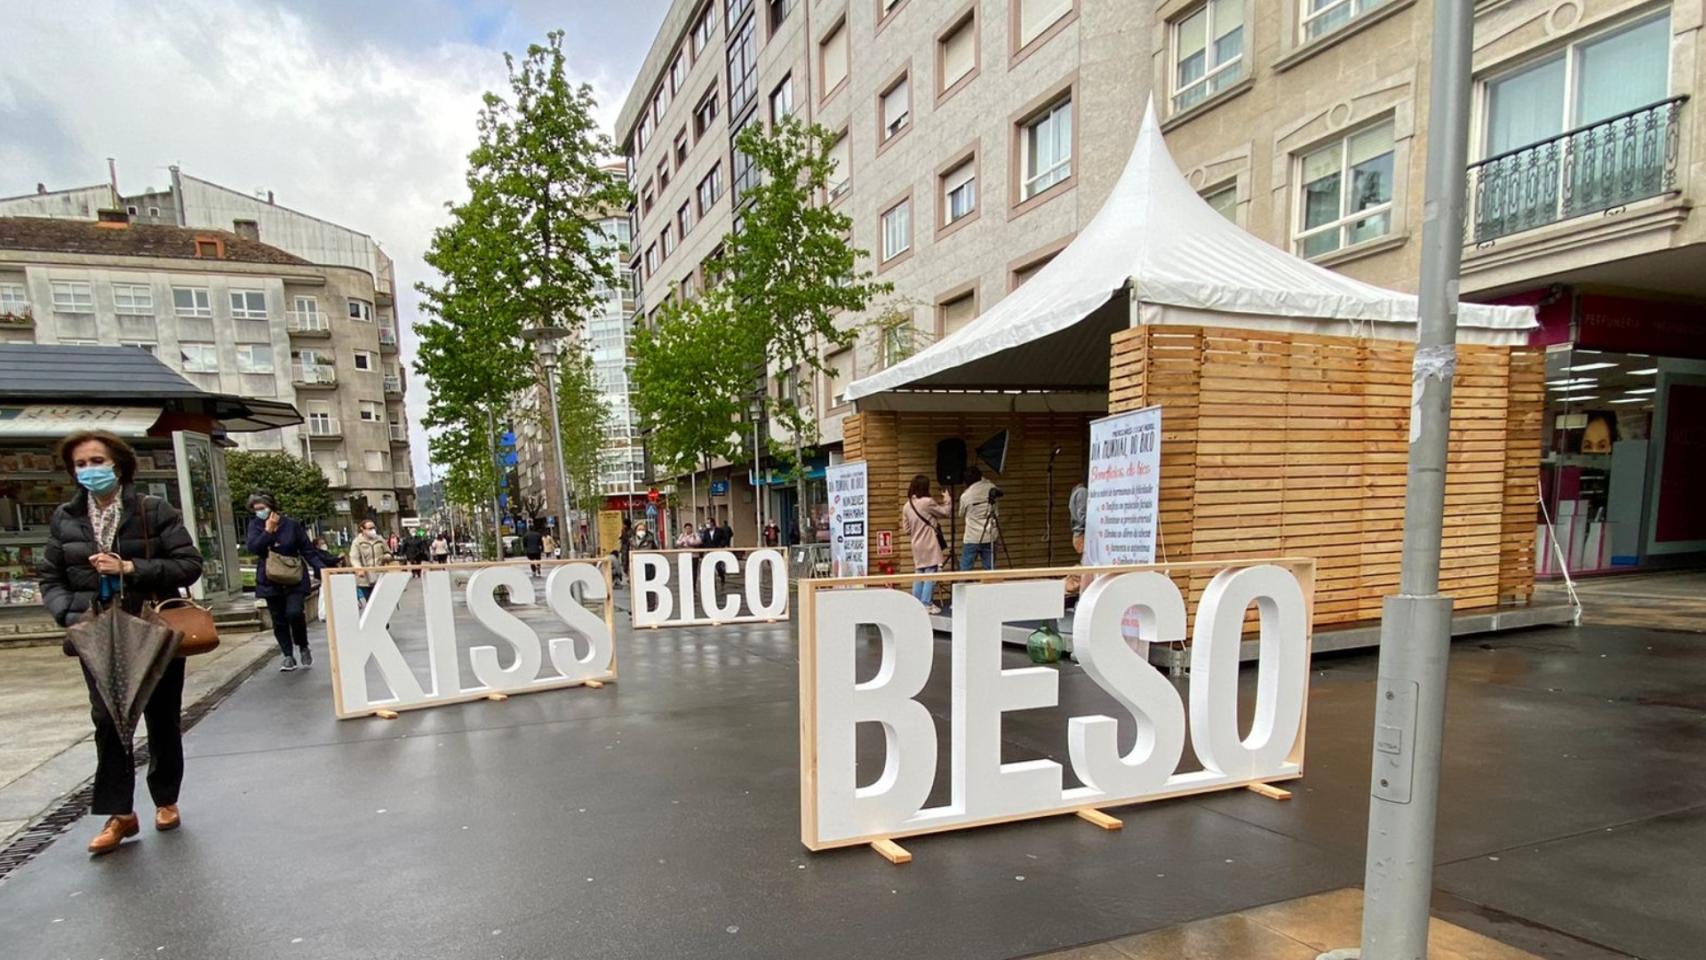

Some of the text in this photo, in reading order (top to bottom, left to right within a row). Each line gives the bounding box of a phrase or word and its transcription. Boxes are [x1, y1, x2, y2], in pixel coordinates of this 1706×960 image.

[1102, 437, 1127, 459] MUNDIAL
[1140, 431, 1155, 453] BICO
[329, 562, 614, 713] KISS
[633, 550, 787, 624] BICO
[816, 565, 1307, 842] BESO
